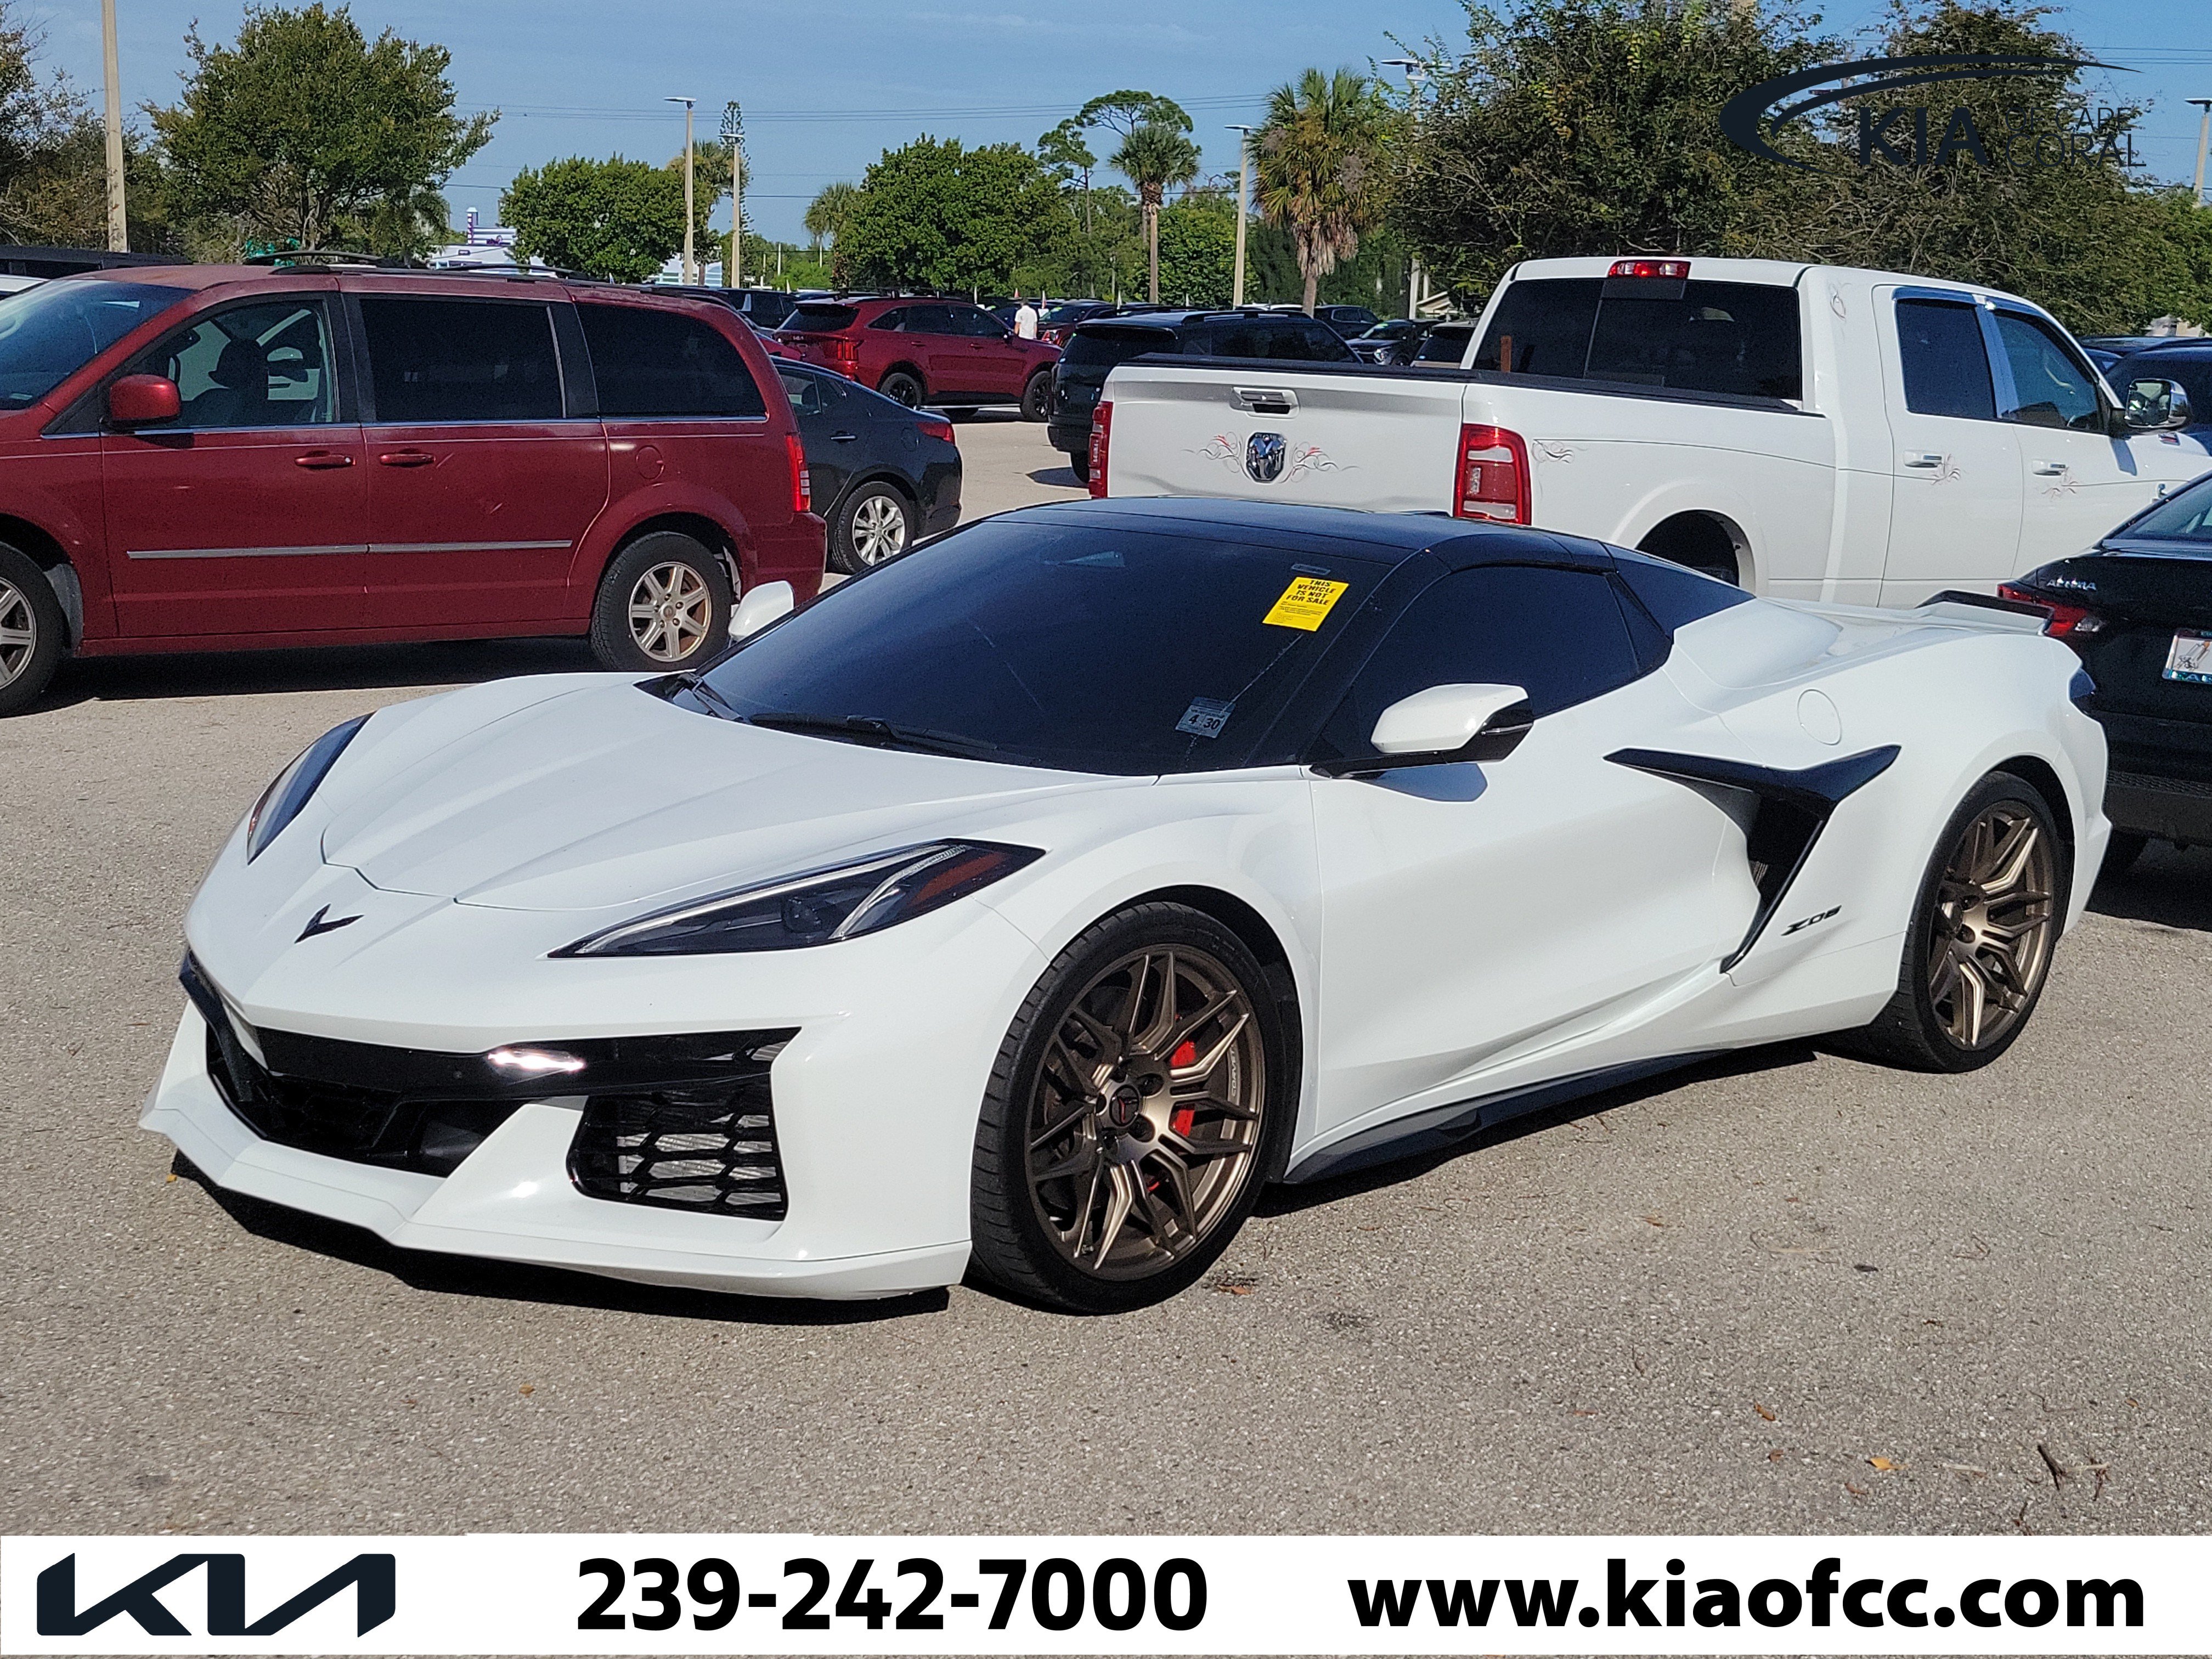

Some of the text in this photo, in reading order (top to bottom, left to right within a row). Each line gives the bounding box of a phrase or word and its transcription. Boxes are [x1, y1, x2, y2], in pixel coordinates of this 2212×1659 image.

[1297, 584, 1336, 594] VEHICLE
[1306, 597, 1330, 606] SALE
[1188, 714, 1221, 730] 4 30
[1781, 904, 1842, 936] Z06
